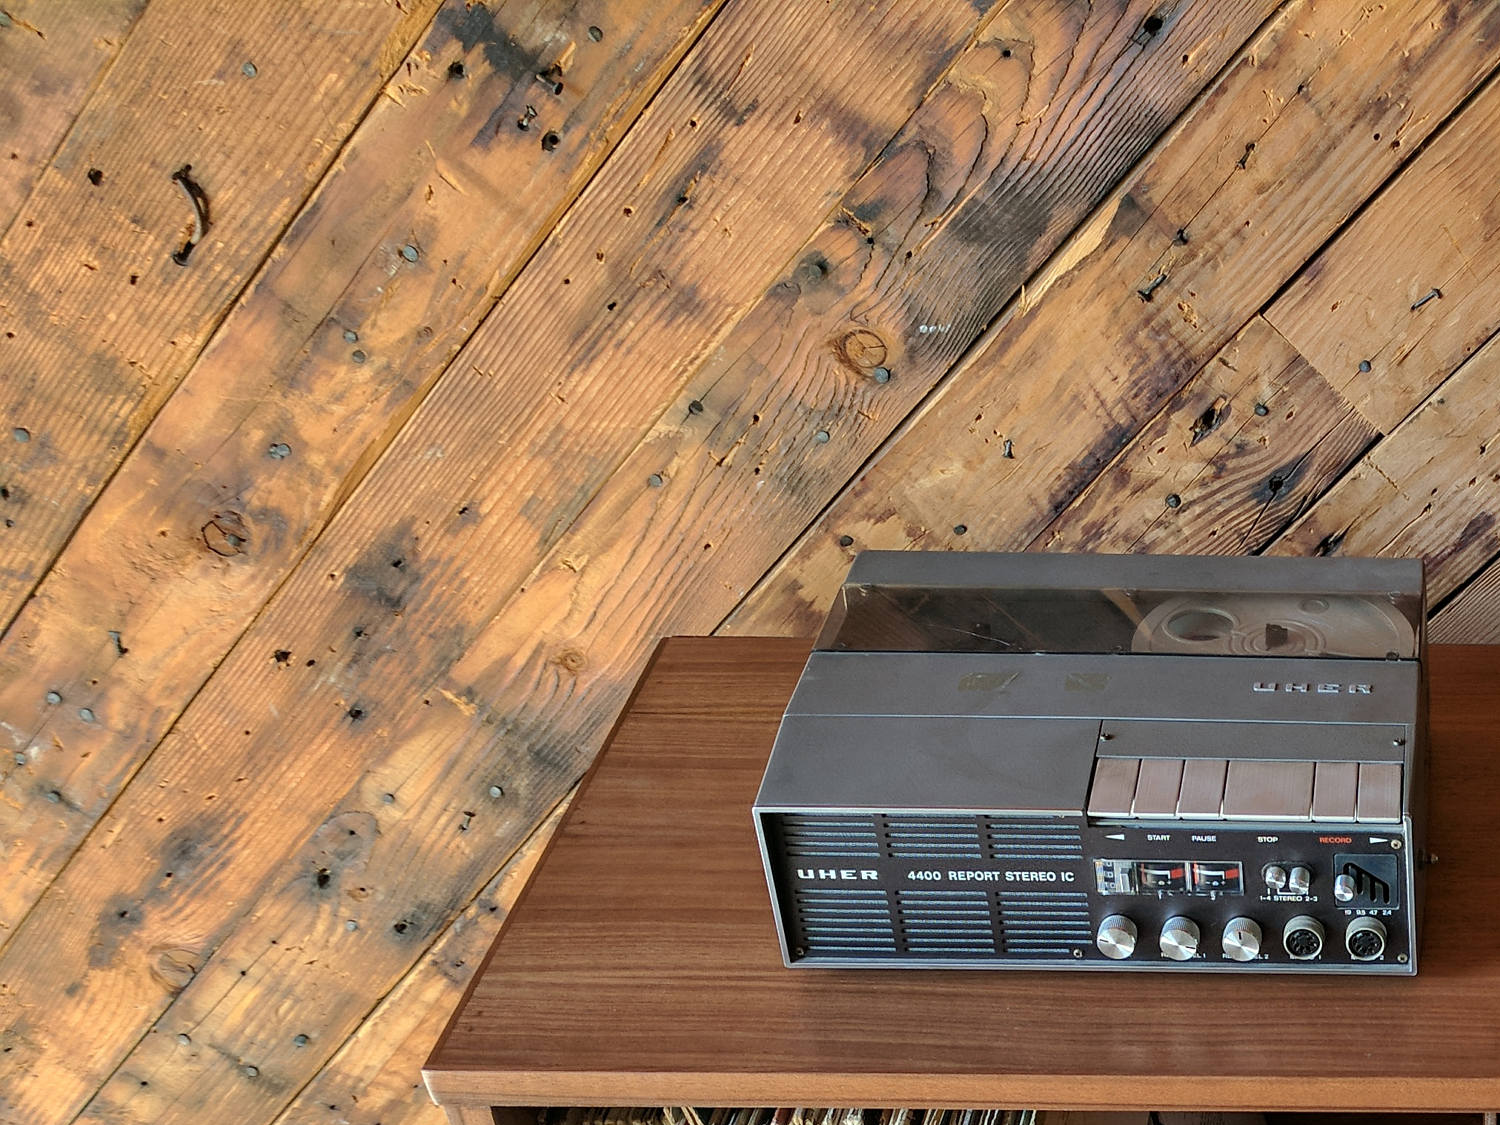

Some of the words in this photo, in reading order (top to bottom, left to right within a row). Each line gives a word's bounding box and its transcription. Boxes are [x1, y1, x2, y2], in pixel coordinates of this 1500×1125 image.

[1253, 682, 1374, 694] UHER
[1147, 834, 1171, 842] START
[1192, 834, 1217, 842] PAUSE
[1319, 836, 1352, 844] RECORD
[798, 869, 879, 880] UHER
[907, 870, 942, 881] 4400
[948, 871, 1000, 881] REPORT
[1005, 871, 1057, 882] STEREO
[1061, 871, 1075, 882] IC
